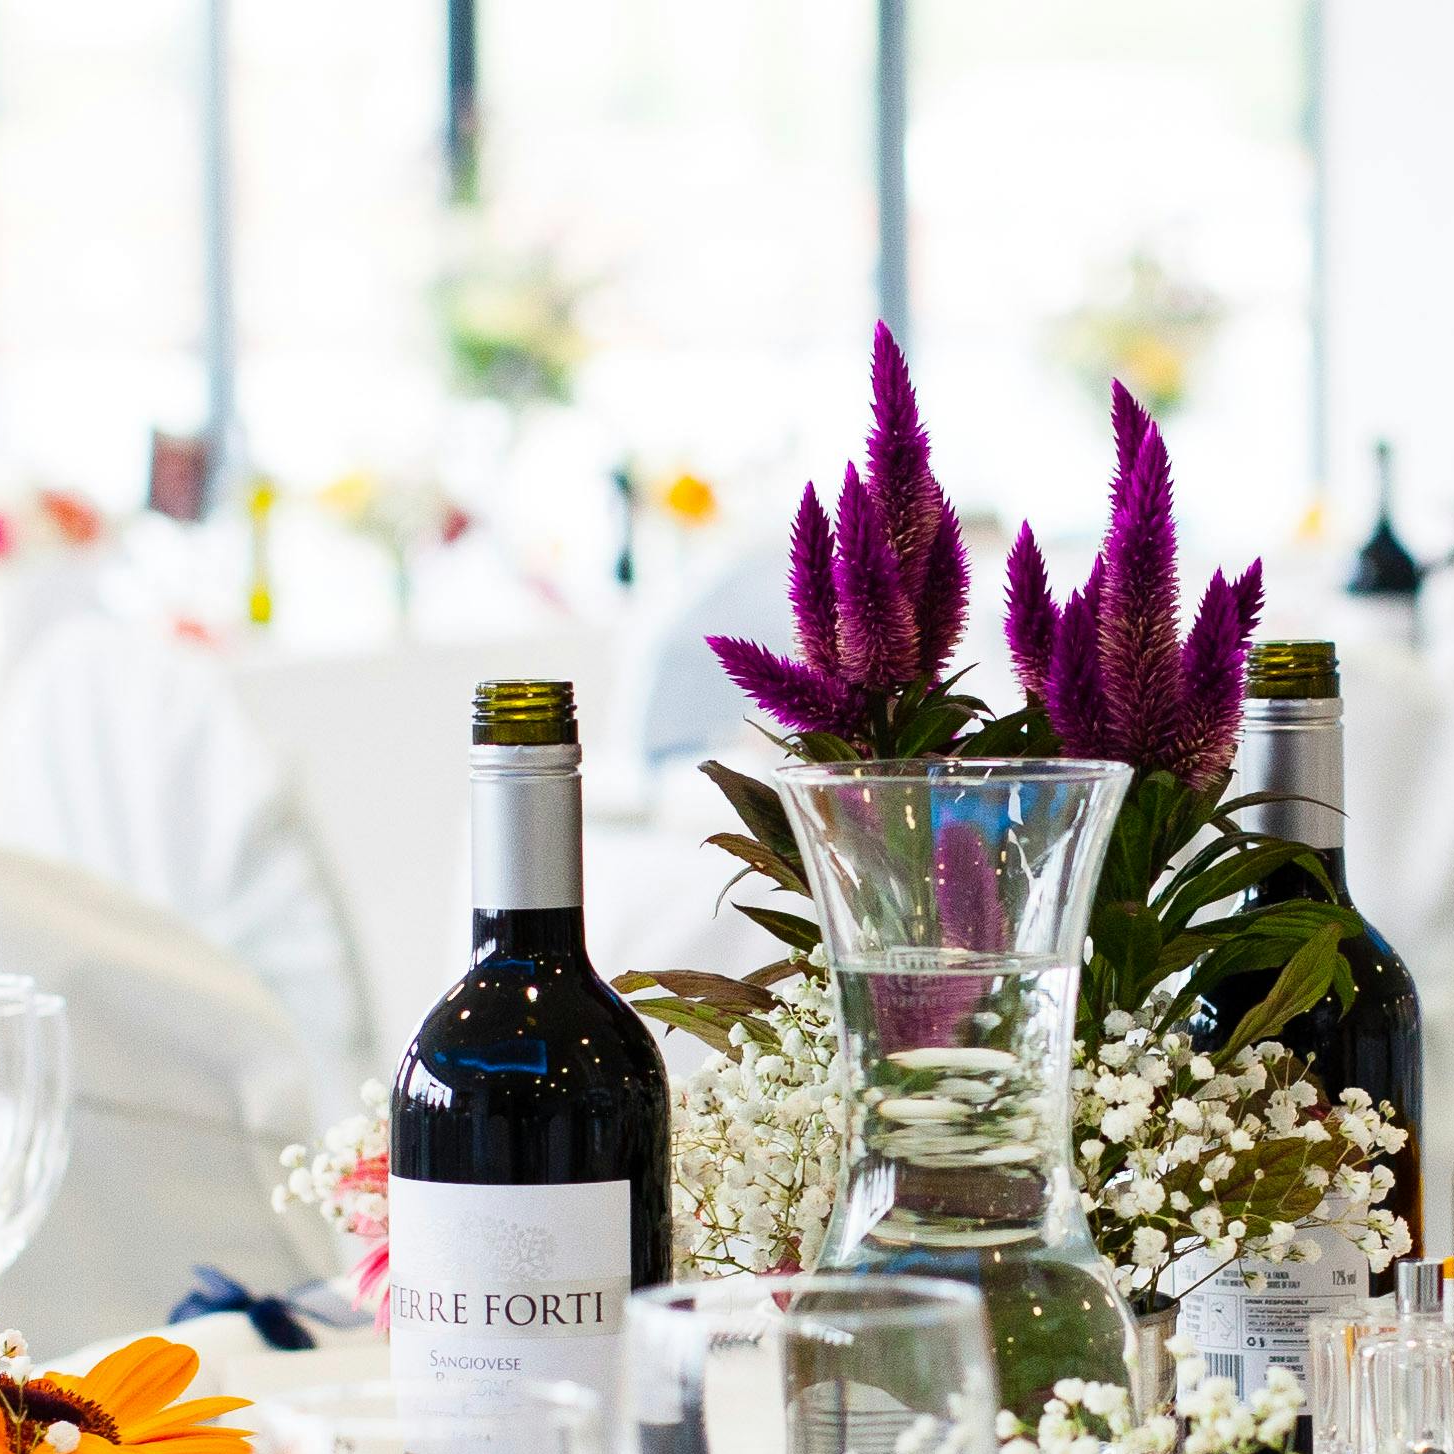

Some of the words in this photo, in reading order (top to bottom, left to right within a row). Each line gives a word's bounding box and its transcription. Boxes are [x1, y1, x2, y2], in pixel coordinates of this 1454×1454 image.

[392, 1284, 467, 1325] TERRE
[485, 1291, 603, 1326] FORTI
[429, 1350, 522, 1371] SANGIOVESE
